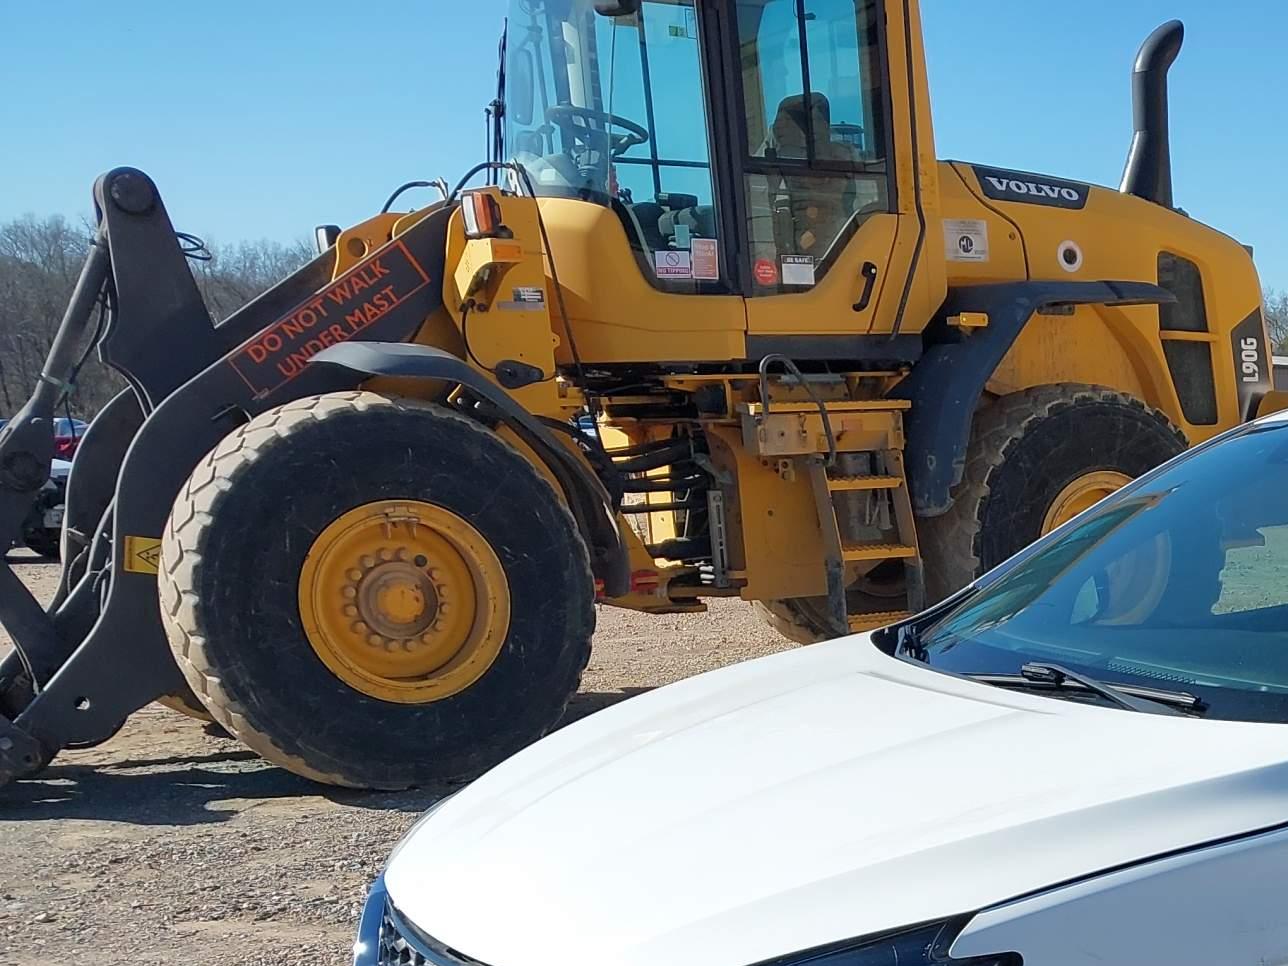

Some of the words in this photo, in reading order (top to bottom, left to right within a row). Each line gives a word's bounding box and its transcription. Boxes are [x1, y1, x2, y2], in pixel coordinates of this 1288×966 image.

[984, 176, 1079, 201] VOLVO
[247, 331, 283, 364] DO
[281, 298, 329, 340] NOT
[327, 259, 391, 306] WALK
[276, 324, 350, 378] UNDER
[345, 285, 399, 330] MAST
[1240, 337, 1259, 382] L90G
